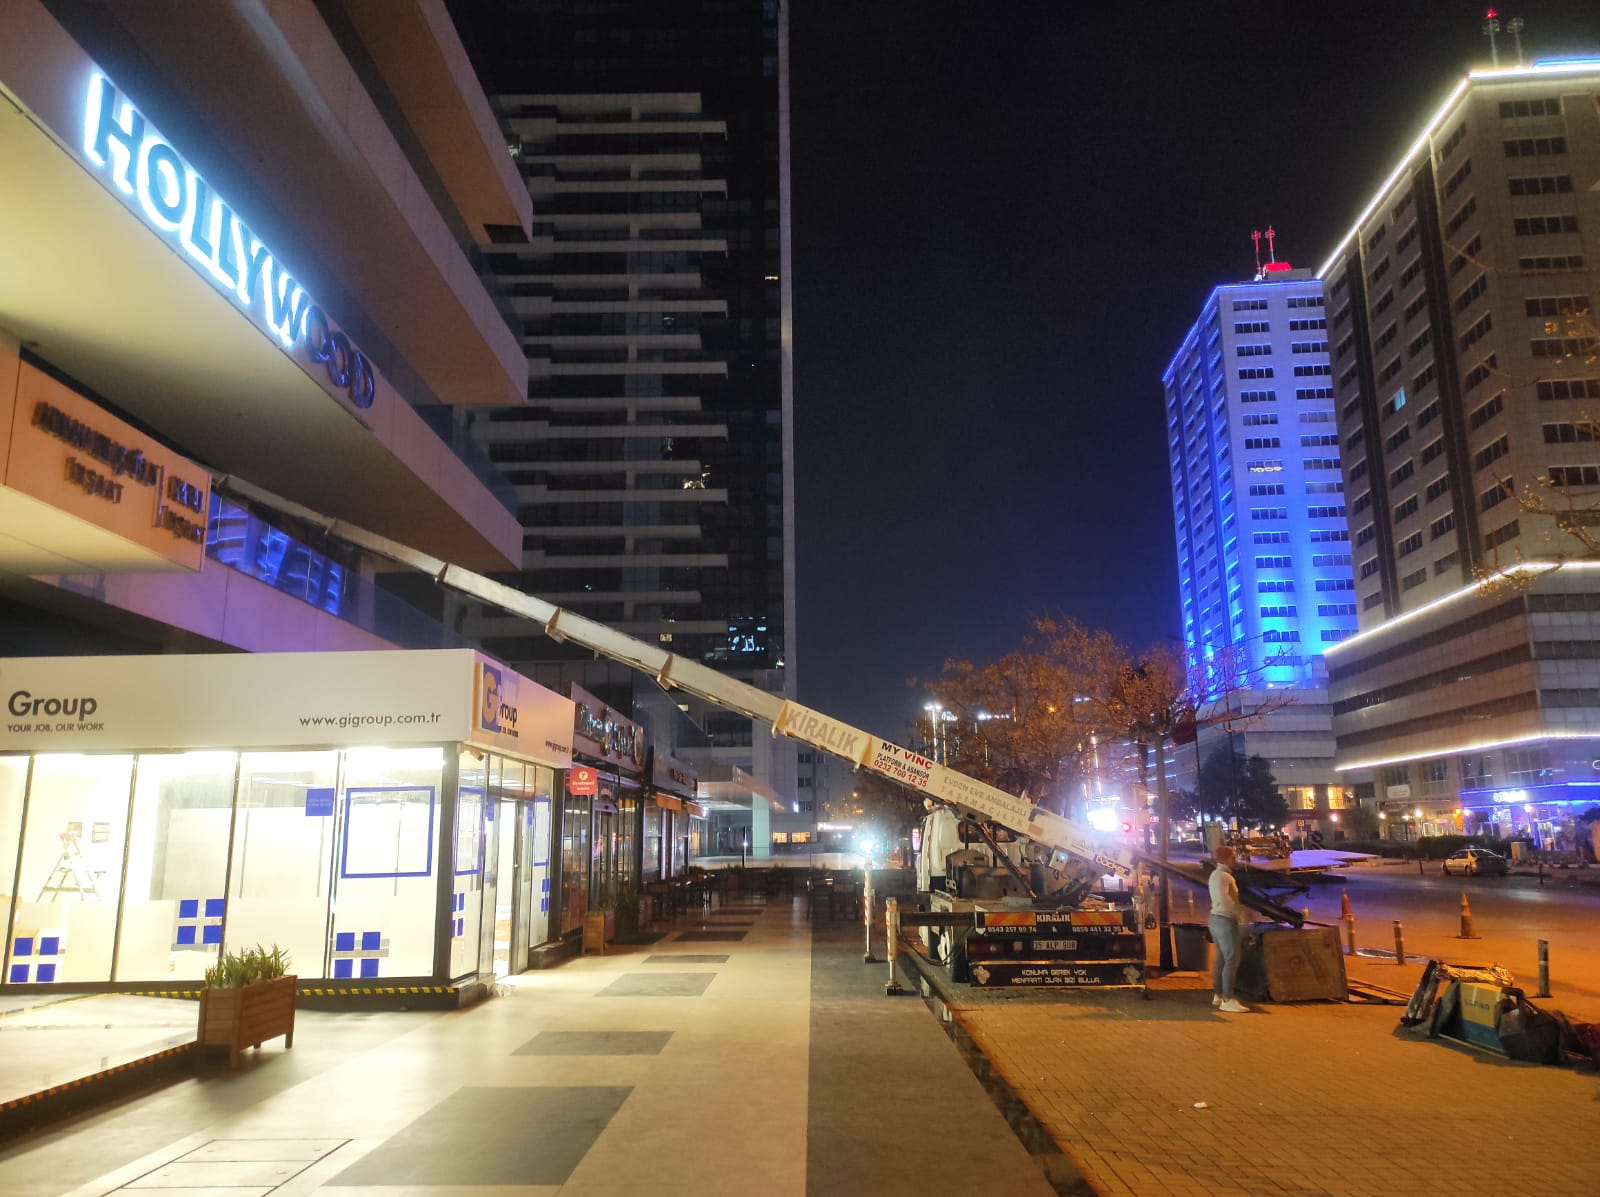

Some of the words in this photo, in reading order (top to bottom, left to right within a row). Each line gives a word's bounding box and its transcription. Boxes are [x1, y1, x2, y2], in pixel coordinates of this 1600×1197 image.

[84, 72, 375, 409] HOLLYWOOD
[8, 690, 97, 721] Group
[8, 724, 32, 733] YOUR
[34, 724, 53, 733] JOB,
[55, 723, 75, 732] OUR
[77, 722, 105, 731] WORK
[299, 712, 441, 728] www.gigroup.com.tr
[784, 709, 860, 755] KİRALIK
[877, 752, 903, 768] PLATFORM
[881, 742, 901, 755] MY
[904, 751, 934, 770] VİNÇ
[874, 759, 892, 772] 0232
[893, 767, 907, 778] 700
[908, 774, 918, 783] 12
[918, 779, 928, 787] 35
[943, 776, 969, 792] EVDEN
[969, 787, 985, 799] EVE
